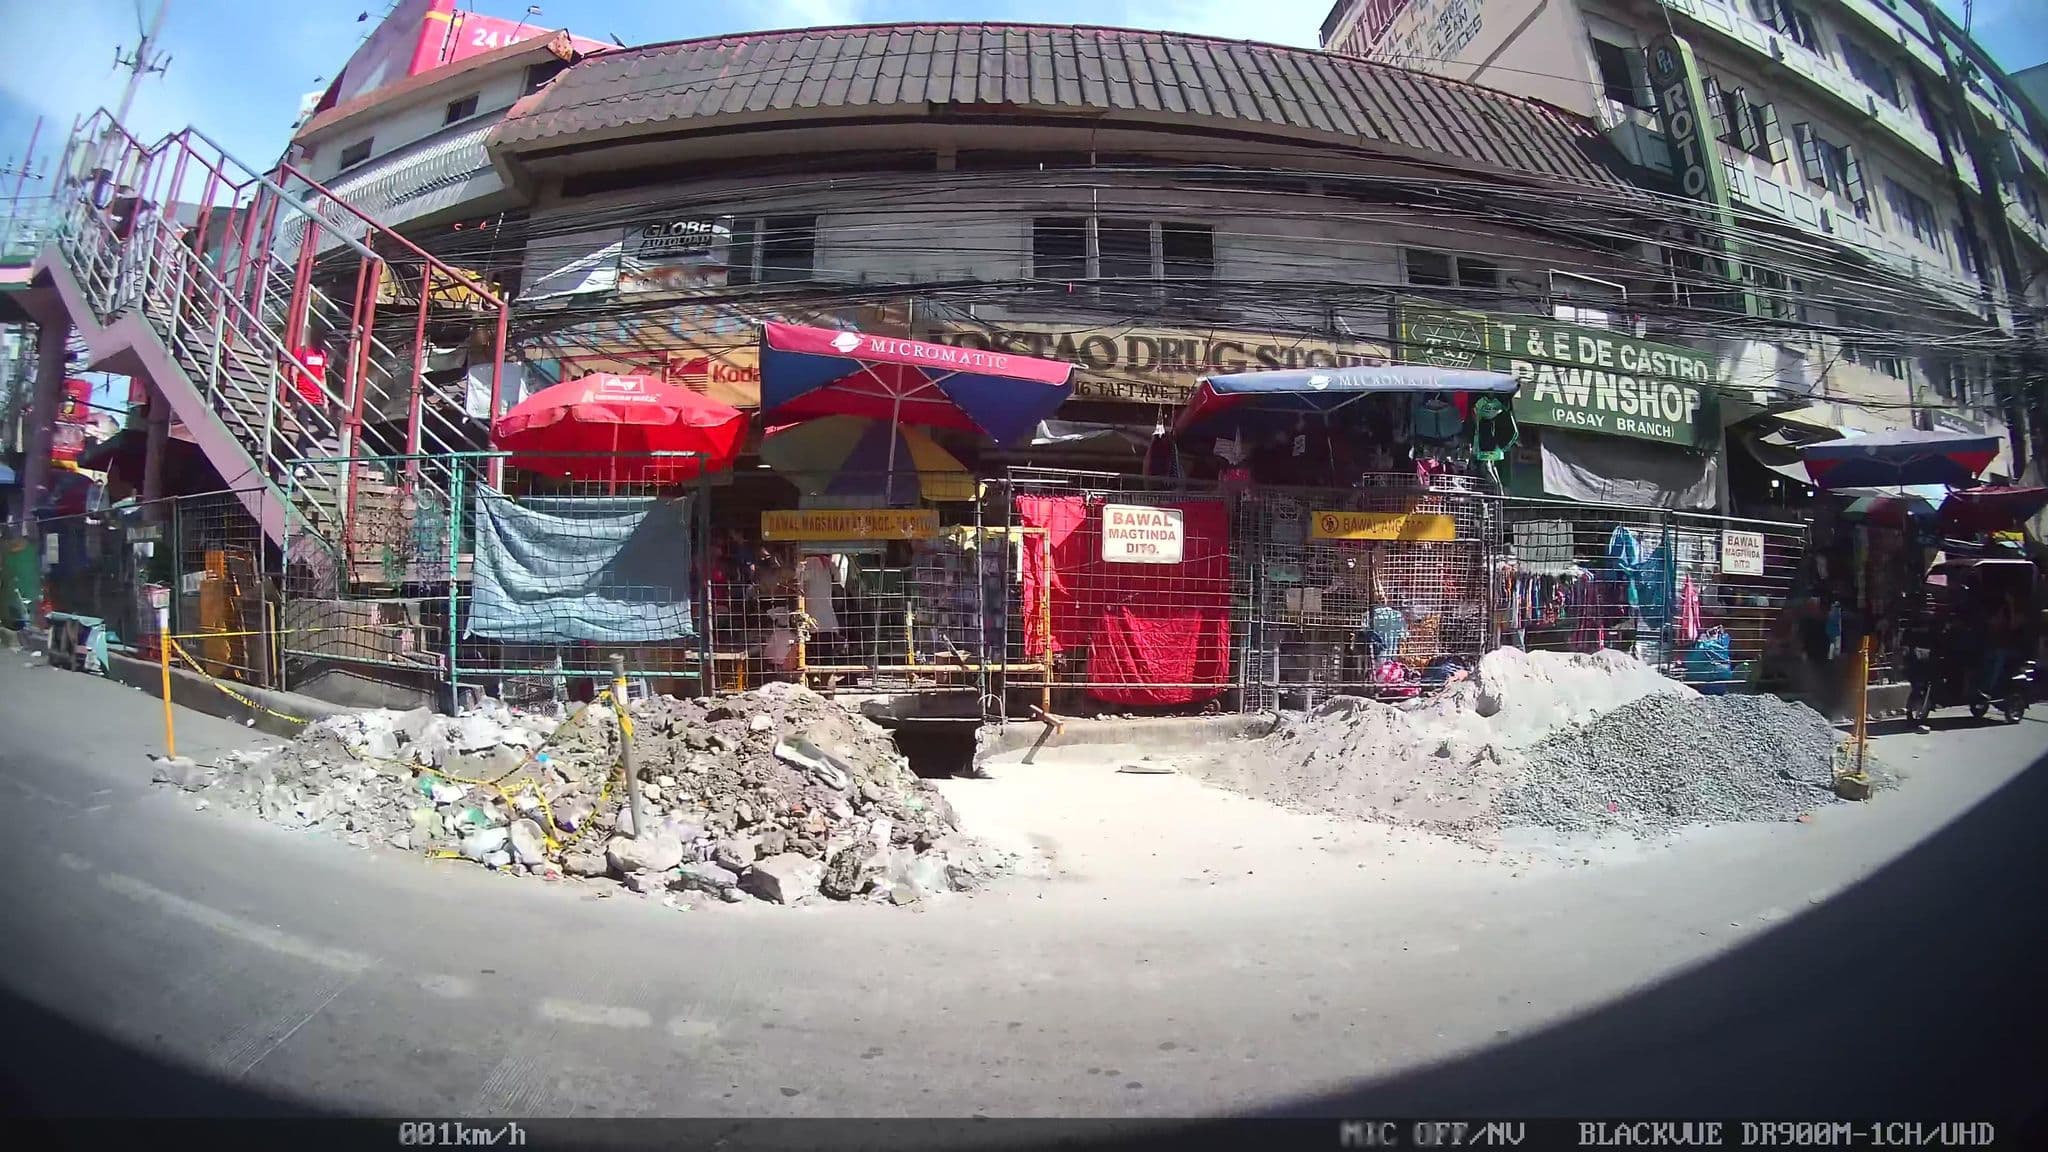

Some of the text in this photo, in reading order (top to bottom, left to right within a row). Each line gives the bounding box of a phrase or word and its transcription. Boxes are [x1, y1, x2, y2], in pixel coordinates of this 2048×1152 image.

[871, 338, 1008, 369] MICROMATIC
[1124, 335, 1248, 375] DRUG
[1499, 324, 1709, 381] T & E DE CASTRO
[1510, 359, 1701, 423] PAWNSHOP
[1108, 528, 1176, 541] MAGTINDA
[1112, 512, 1173, 527] BAWAL
[1728, 535, 1760, 548] BAWAL
